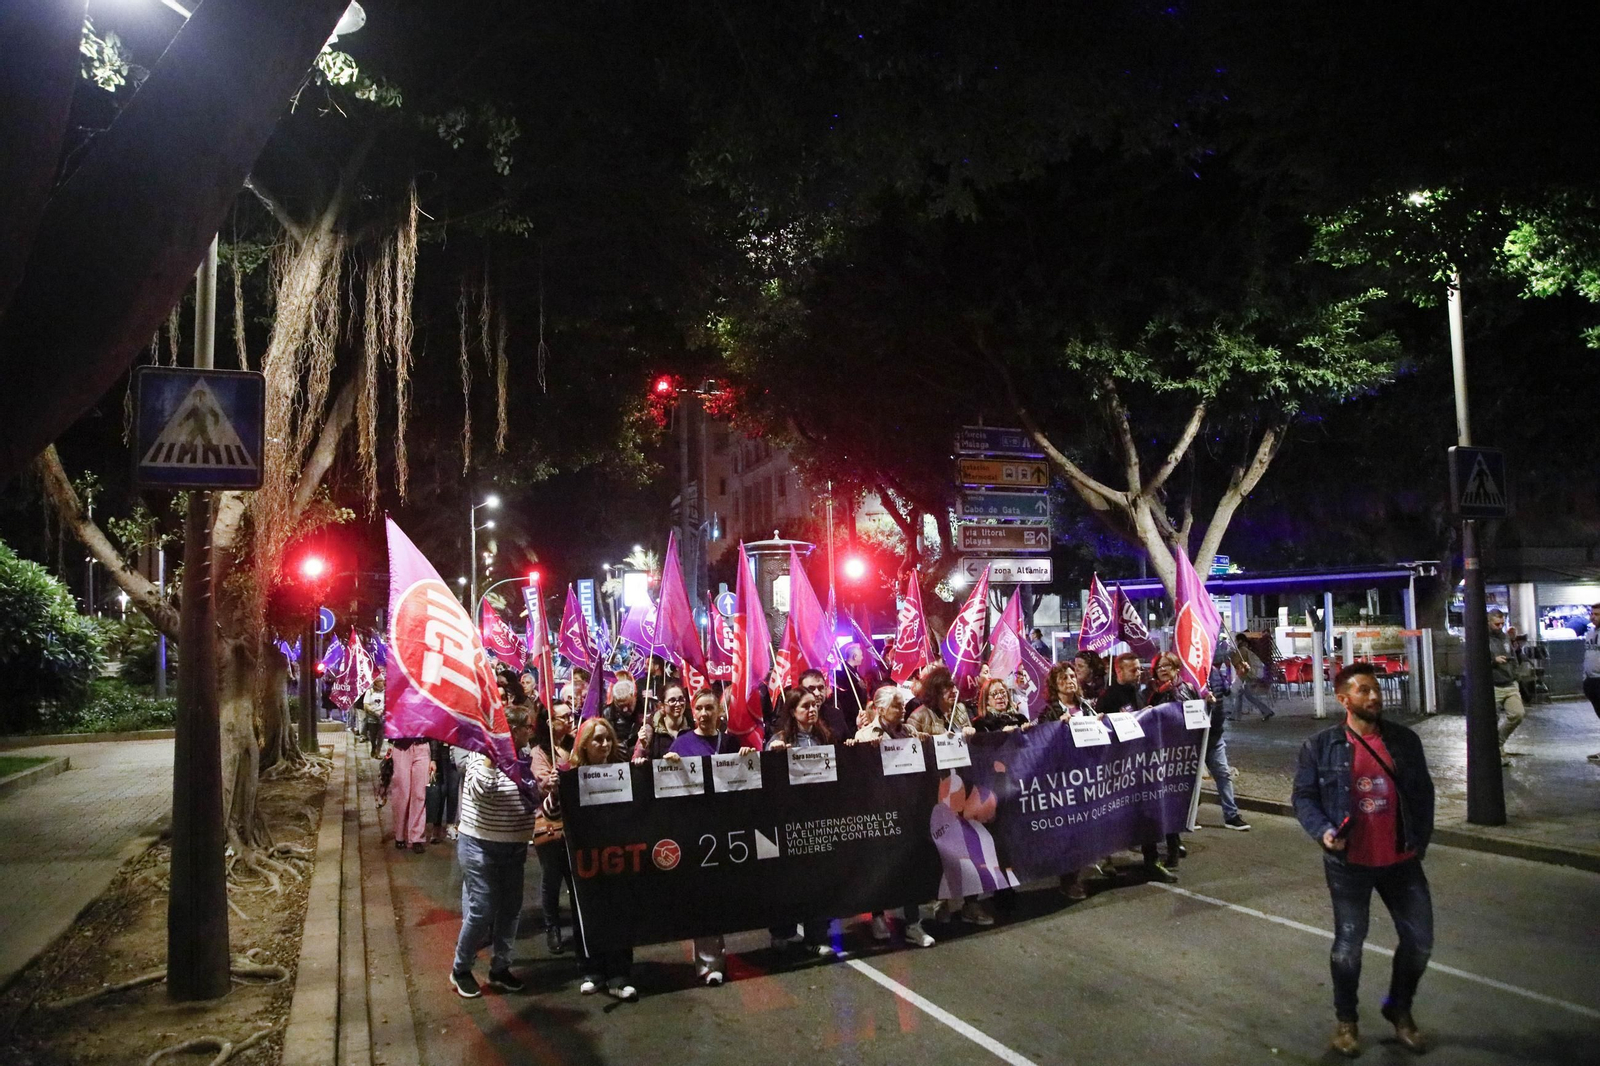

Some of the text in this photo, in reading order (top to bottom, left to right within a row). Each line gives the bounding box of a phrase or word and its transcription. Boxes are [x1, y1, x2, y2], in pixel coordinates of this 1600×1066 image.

[964, 505, 1020, 515] Cabo de Gata
[965, 537, 991, 547] playas
[981, 528, 1006, 537] litoral
[1016, 566, 1049, 575] Altamira
[1019, 776, 1041, 795] LA
[1046, 756, 1132, 789] VIOLENCIA
[1019, 788, 1076, 813] TIENE
[1083, 770, 1136, 803] MUCHOS
[785, 811, 898, 832] DÍA INTERNACIONAL DE
[1031, 816, 1064, 831] SOLO
[1067, 811, 1090, 825] HAY
[1091, 804, 1107, 820] QUE
[1108, 795, 1130, 812] SABER
[786, 820, 895, 840] LA ELIMINACIÓN DE LA
[786, 826, 902, 848] VIOLENCIA CONTRA LAS
[576, 843, 647, 879] UGT
